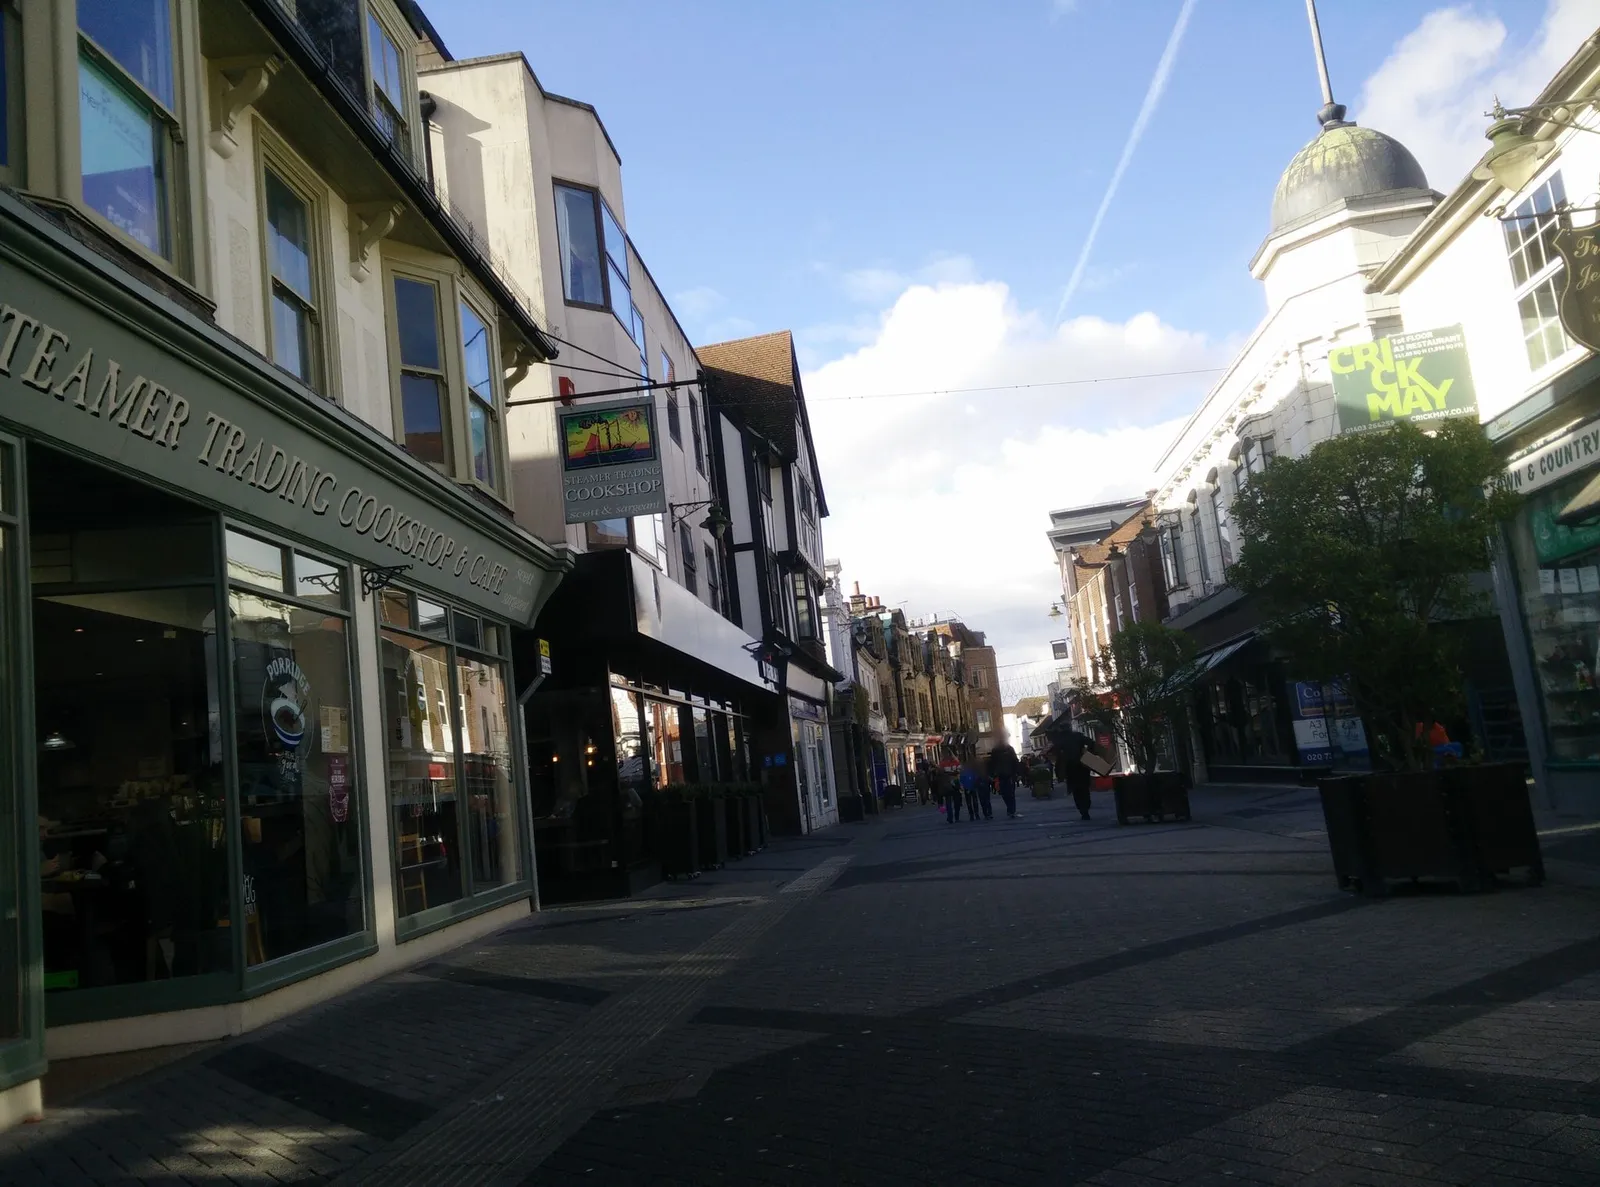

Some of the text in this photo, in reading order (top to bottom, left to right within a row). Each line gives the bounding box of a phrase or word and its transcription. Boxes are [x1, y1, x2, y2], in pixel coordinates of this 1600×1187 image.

[1391, 331, 1434, 346] 1st FLOOR
[1393, 334, 1462, 353] A3 RESTAURANT
[1366, 378, 1454, 421] MAY
[1410, 406, 1476, 422] CRICKMAY.CO.UK
[1345, 424, 1367, 434] 01403
[0, 303, 508, 596] TEAMER TRADING COOKSHOP & CAFE
[1527, 463, 1535, 481] &
[1540, 428, 1600, 476] COUNTRY
[565, 467, 660, 486] STEAMER TRADING
[566, 480, 662, 502] COOKSHOP
[601, 506, 612, 516] &
[266, 657, 311, 696] PORRIDGE
[1309, 720, 1322, 729] A3
